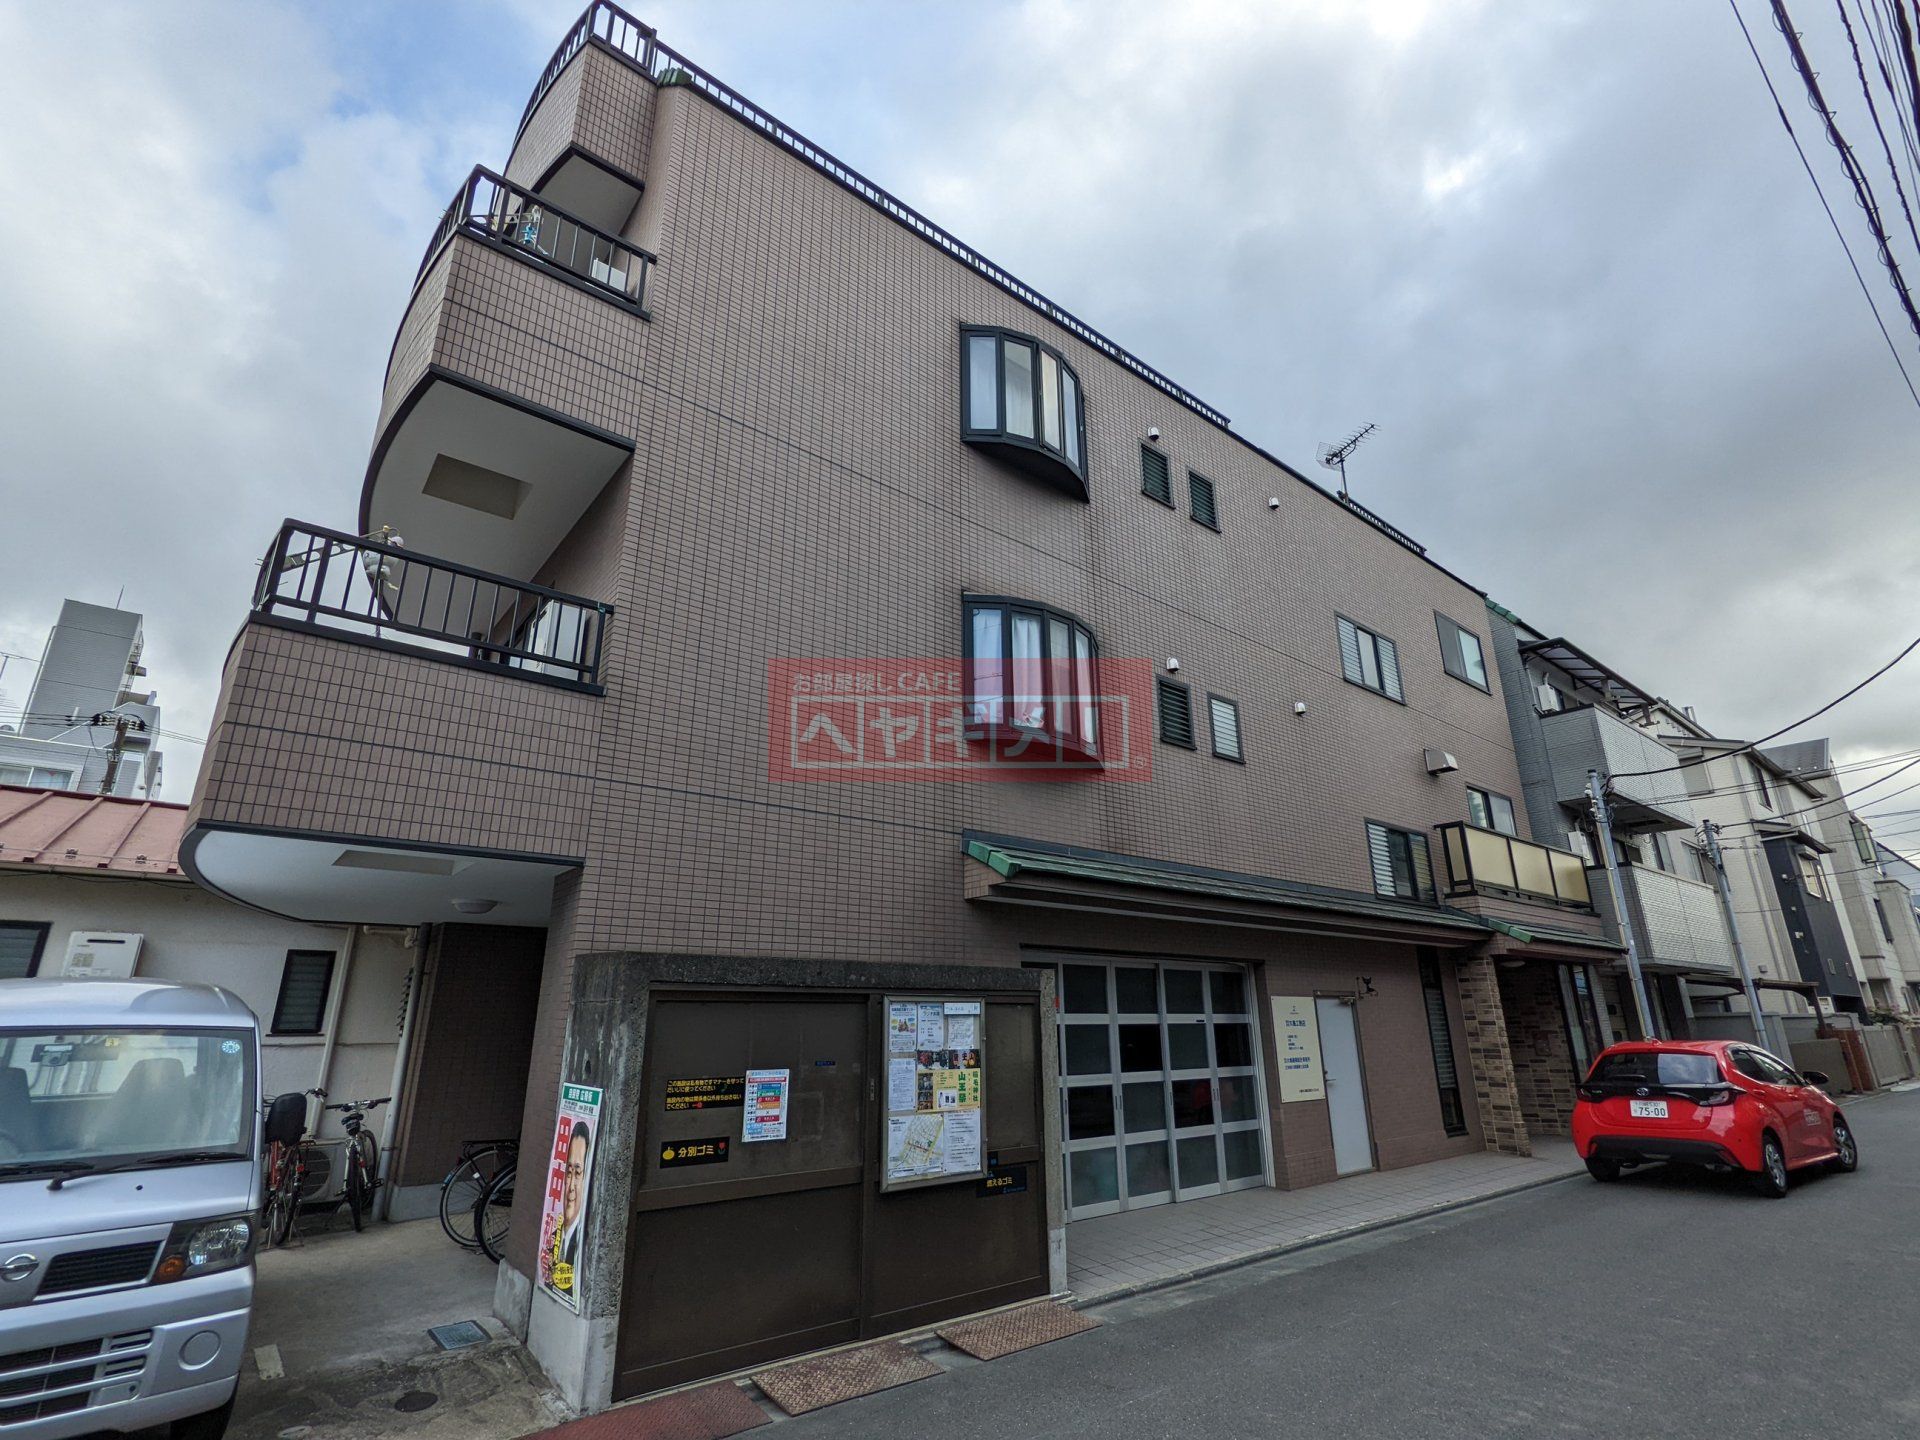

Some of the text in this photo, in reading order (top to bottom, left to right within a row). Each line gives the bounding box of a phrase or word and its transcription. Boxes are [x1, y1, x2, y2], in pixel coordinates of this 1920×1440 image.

[1638, 1106, 1666, 1117] 75-00
[677, 1144, 715, 1158] 分別ゴミ
[986, 1176, 1013, 1188] 燃えるゴミ
